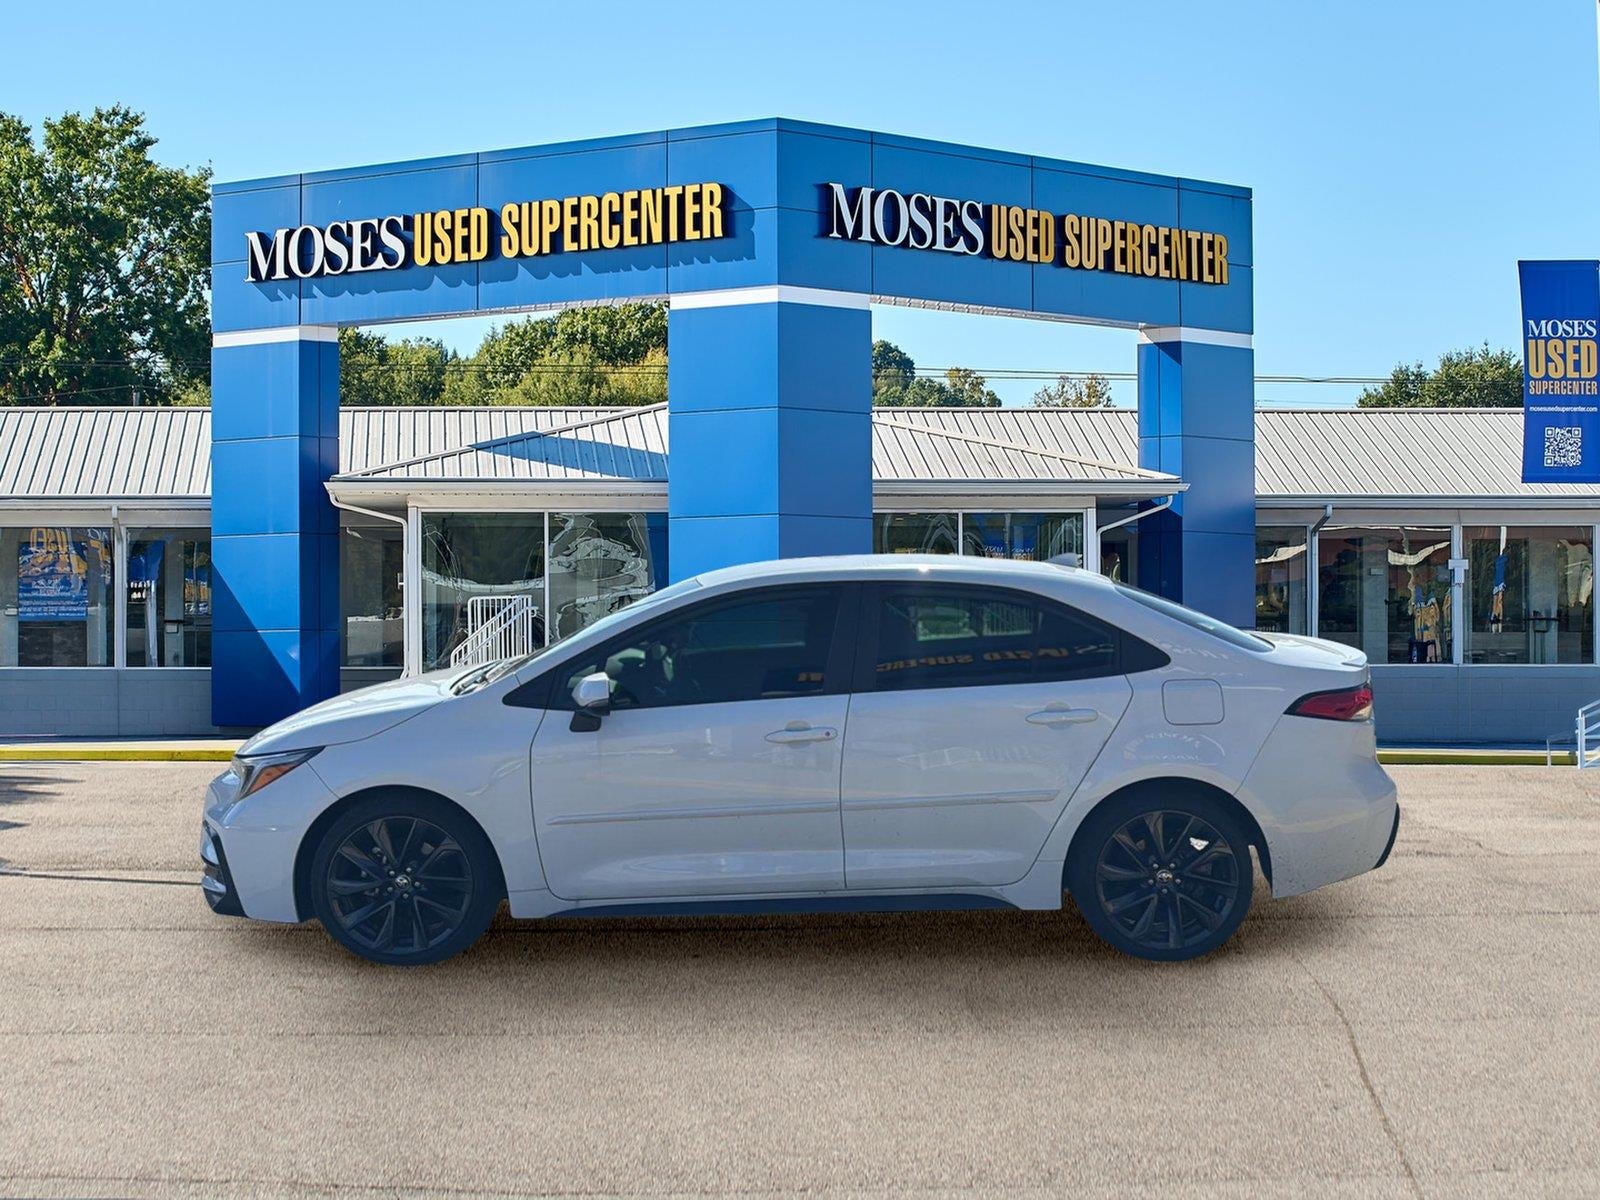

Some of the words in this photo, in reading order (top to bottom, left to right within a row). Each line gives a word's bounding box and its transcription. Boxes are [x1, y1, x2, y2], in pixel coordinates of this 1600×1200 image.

[244, 214, 407, 283] MOSES
[413, 206, 489, 267] USED
[500, 181, 724, 259] SUPERCENTER
[828, 182, 985, 256] MOSES
[991, 203, 1055, 264] USED
[1064, 212, 1229, 285] SUPERCENTER
[1527, 319, 1597, 338] MOSES
[1528, 338, 1598, 379] USED
[1529, 380, 1598, 396] SUPERCENTER
[1529, 405, 1598, 413] mosesusedsupercenter.com
